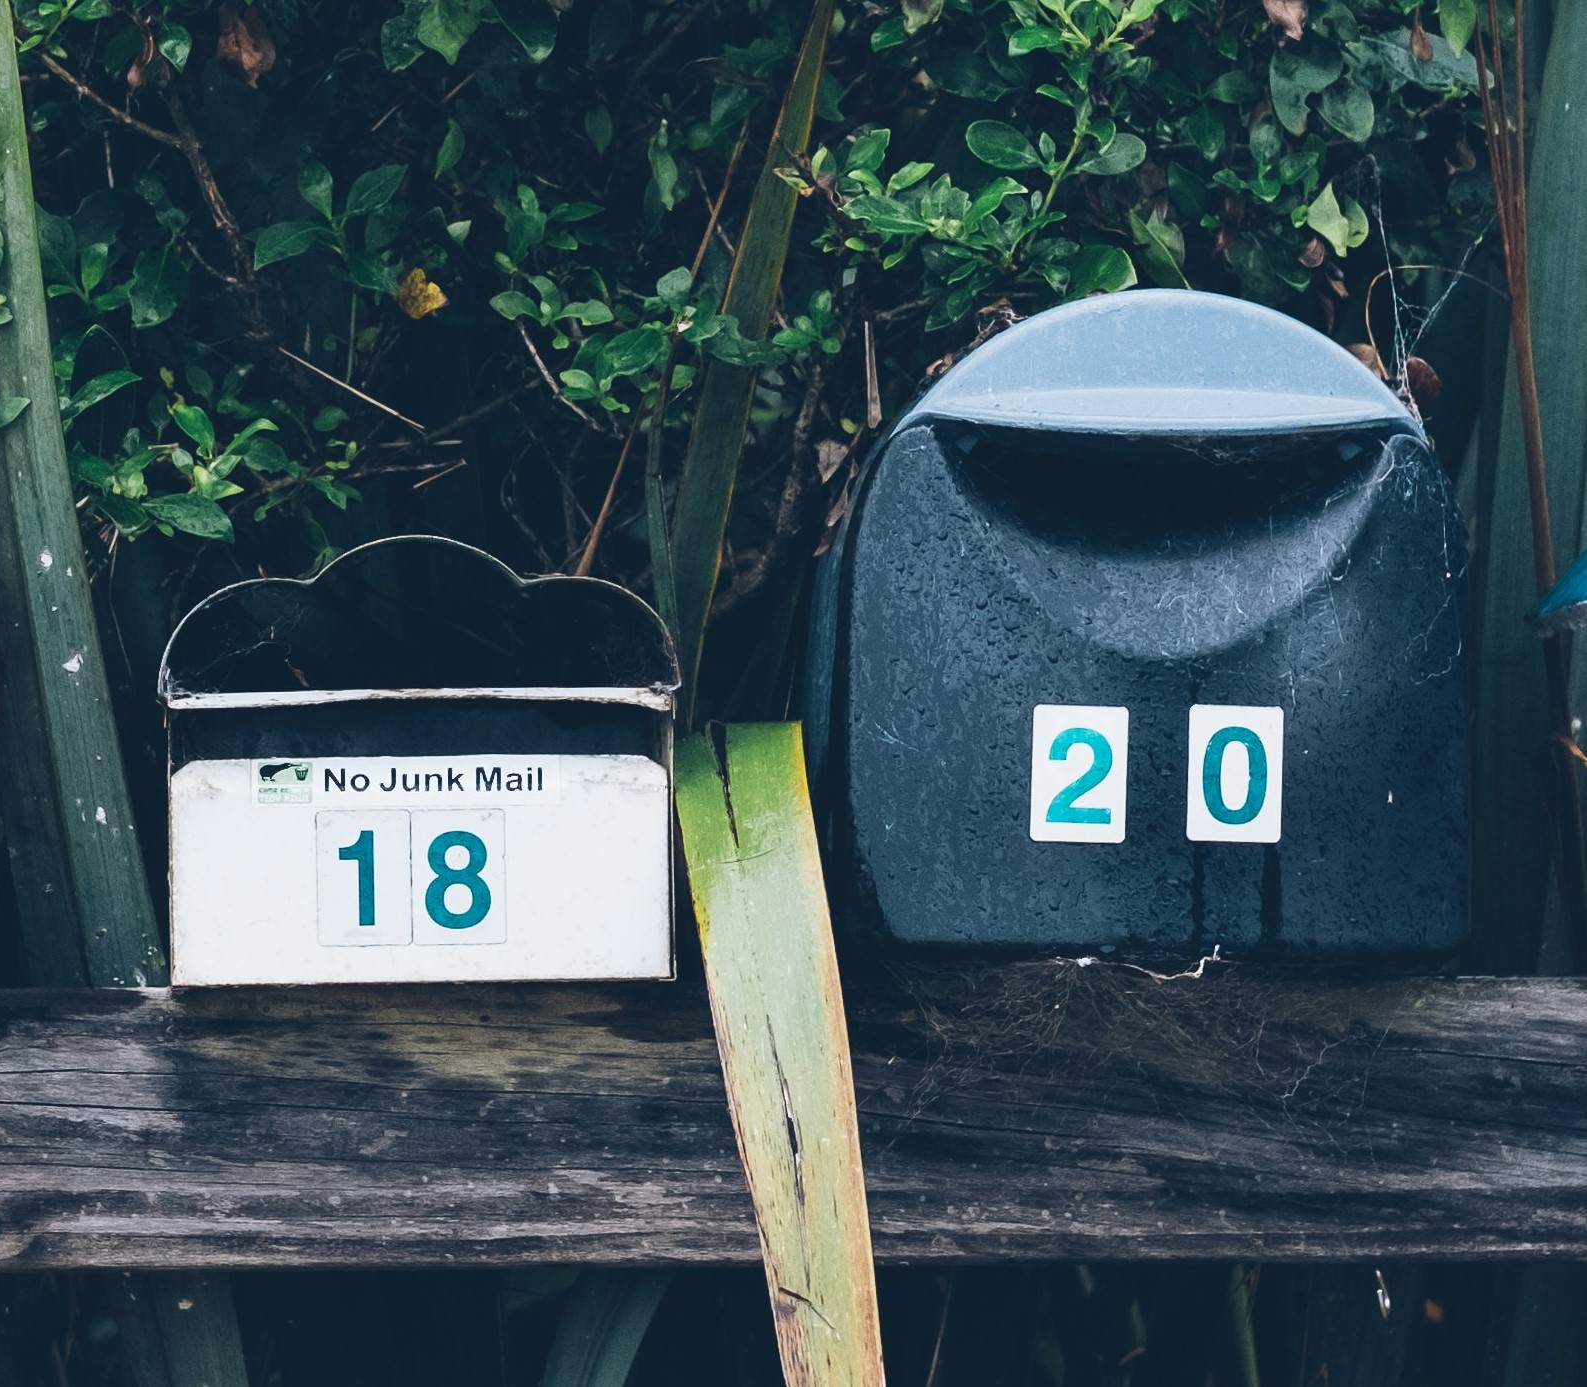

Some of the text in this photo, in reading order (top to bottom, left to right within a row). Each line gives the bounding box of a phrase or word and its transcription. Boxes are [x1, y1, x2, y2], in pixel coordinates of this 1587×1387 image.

[324, 766, 543, 792] No Junk Mail
[338, 829, 492, 929] 18
